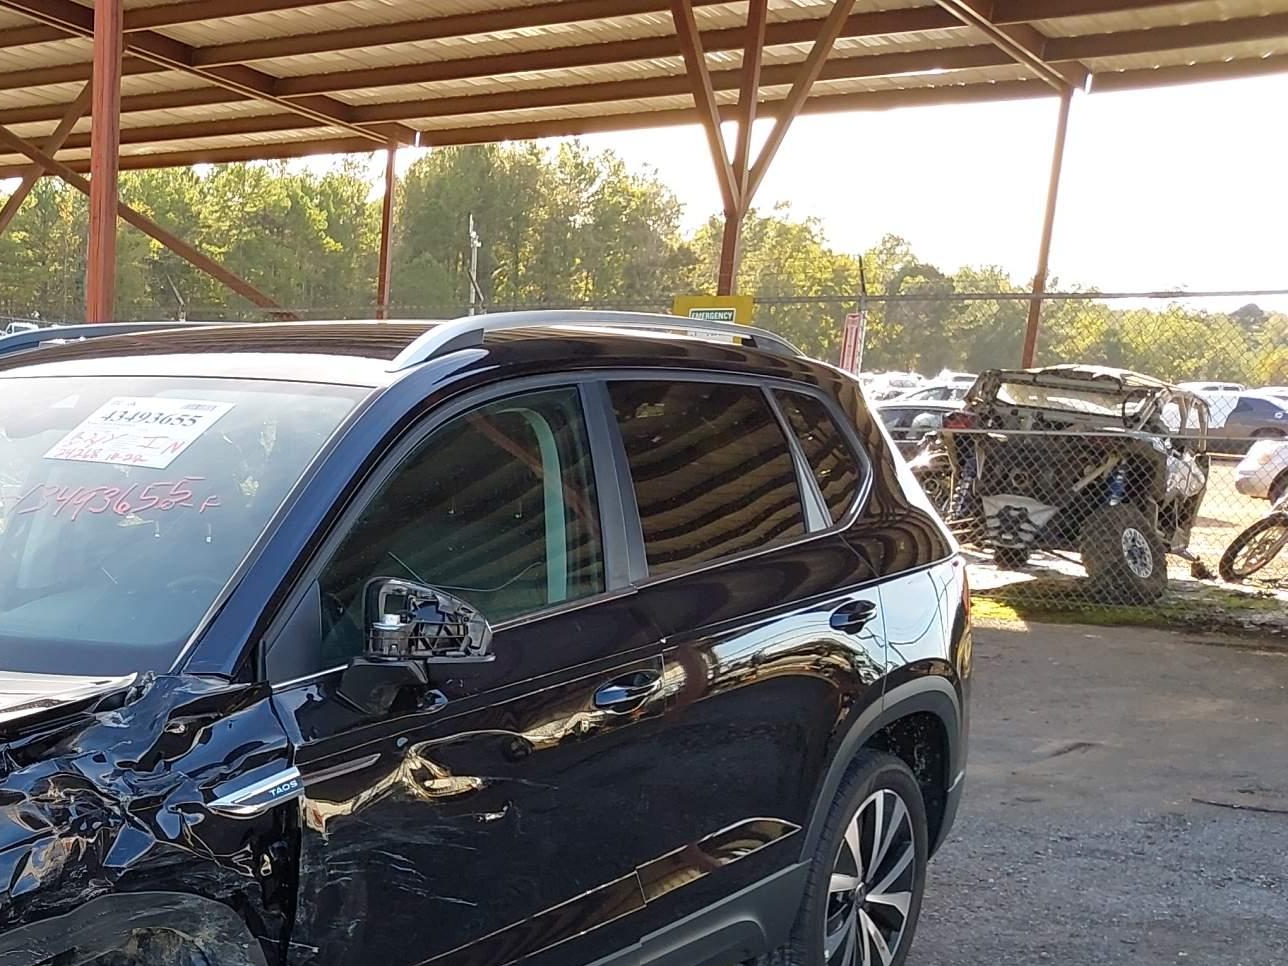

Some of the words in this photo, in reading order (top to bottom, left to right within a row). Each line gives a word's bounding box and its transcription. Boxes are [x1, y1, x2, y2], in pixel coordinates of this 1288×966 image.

[691, 311, 733, 320] EMERGENCY
[101, 410, 204, 427] 43493655
[270, 780, 298, 797] TAOS
